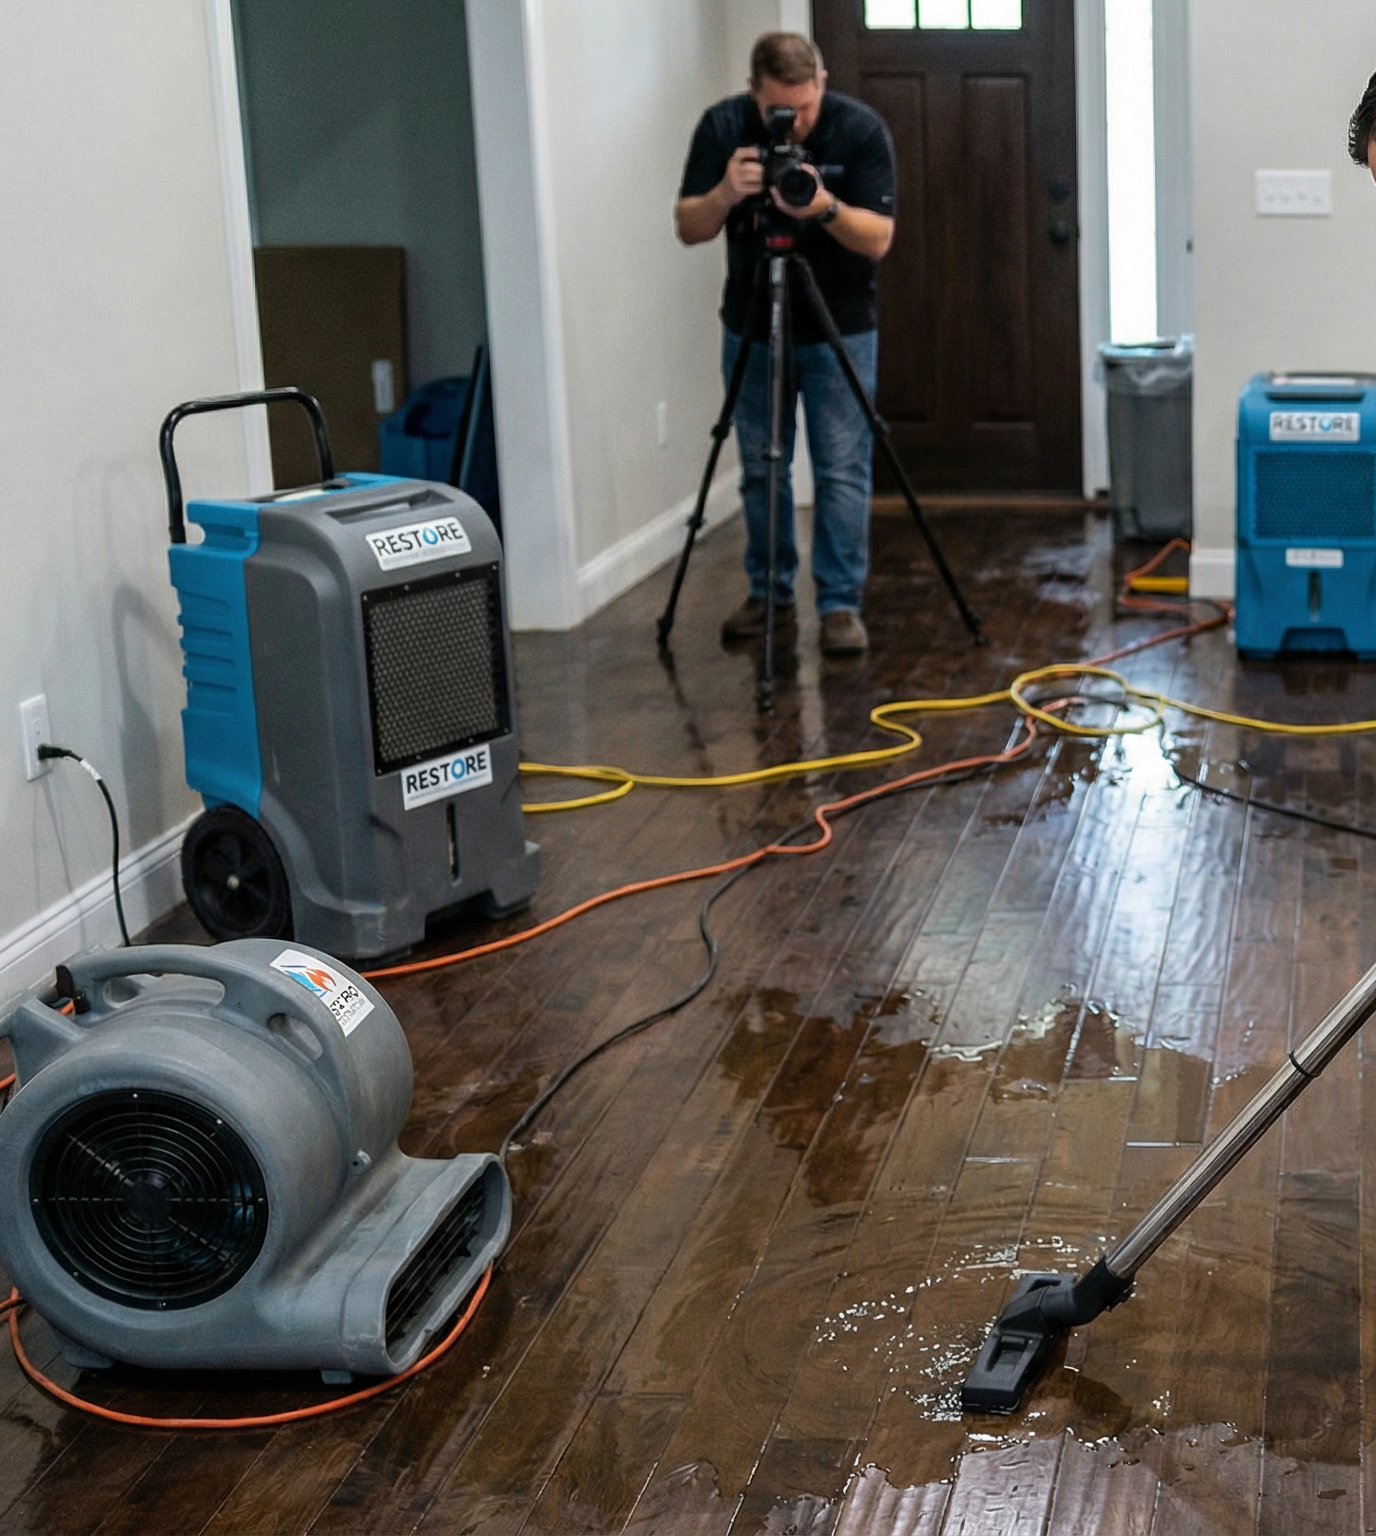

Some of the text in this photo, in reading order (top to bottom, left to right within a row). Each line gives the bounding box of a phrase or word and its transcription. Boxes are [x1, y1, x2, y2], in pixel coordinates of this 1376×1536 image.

[1272, 414, 1354, 432] RESTORE
[372, 522, 464, 556] RESTORE
[406, 751, 488, 794] RESTORE
